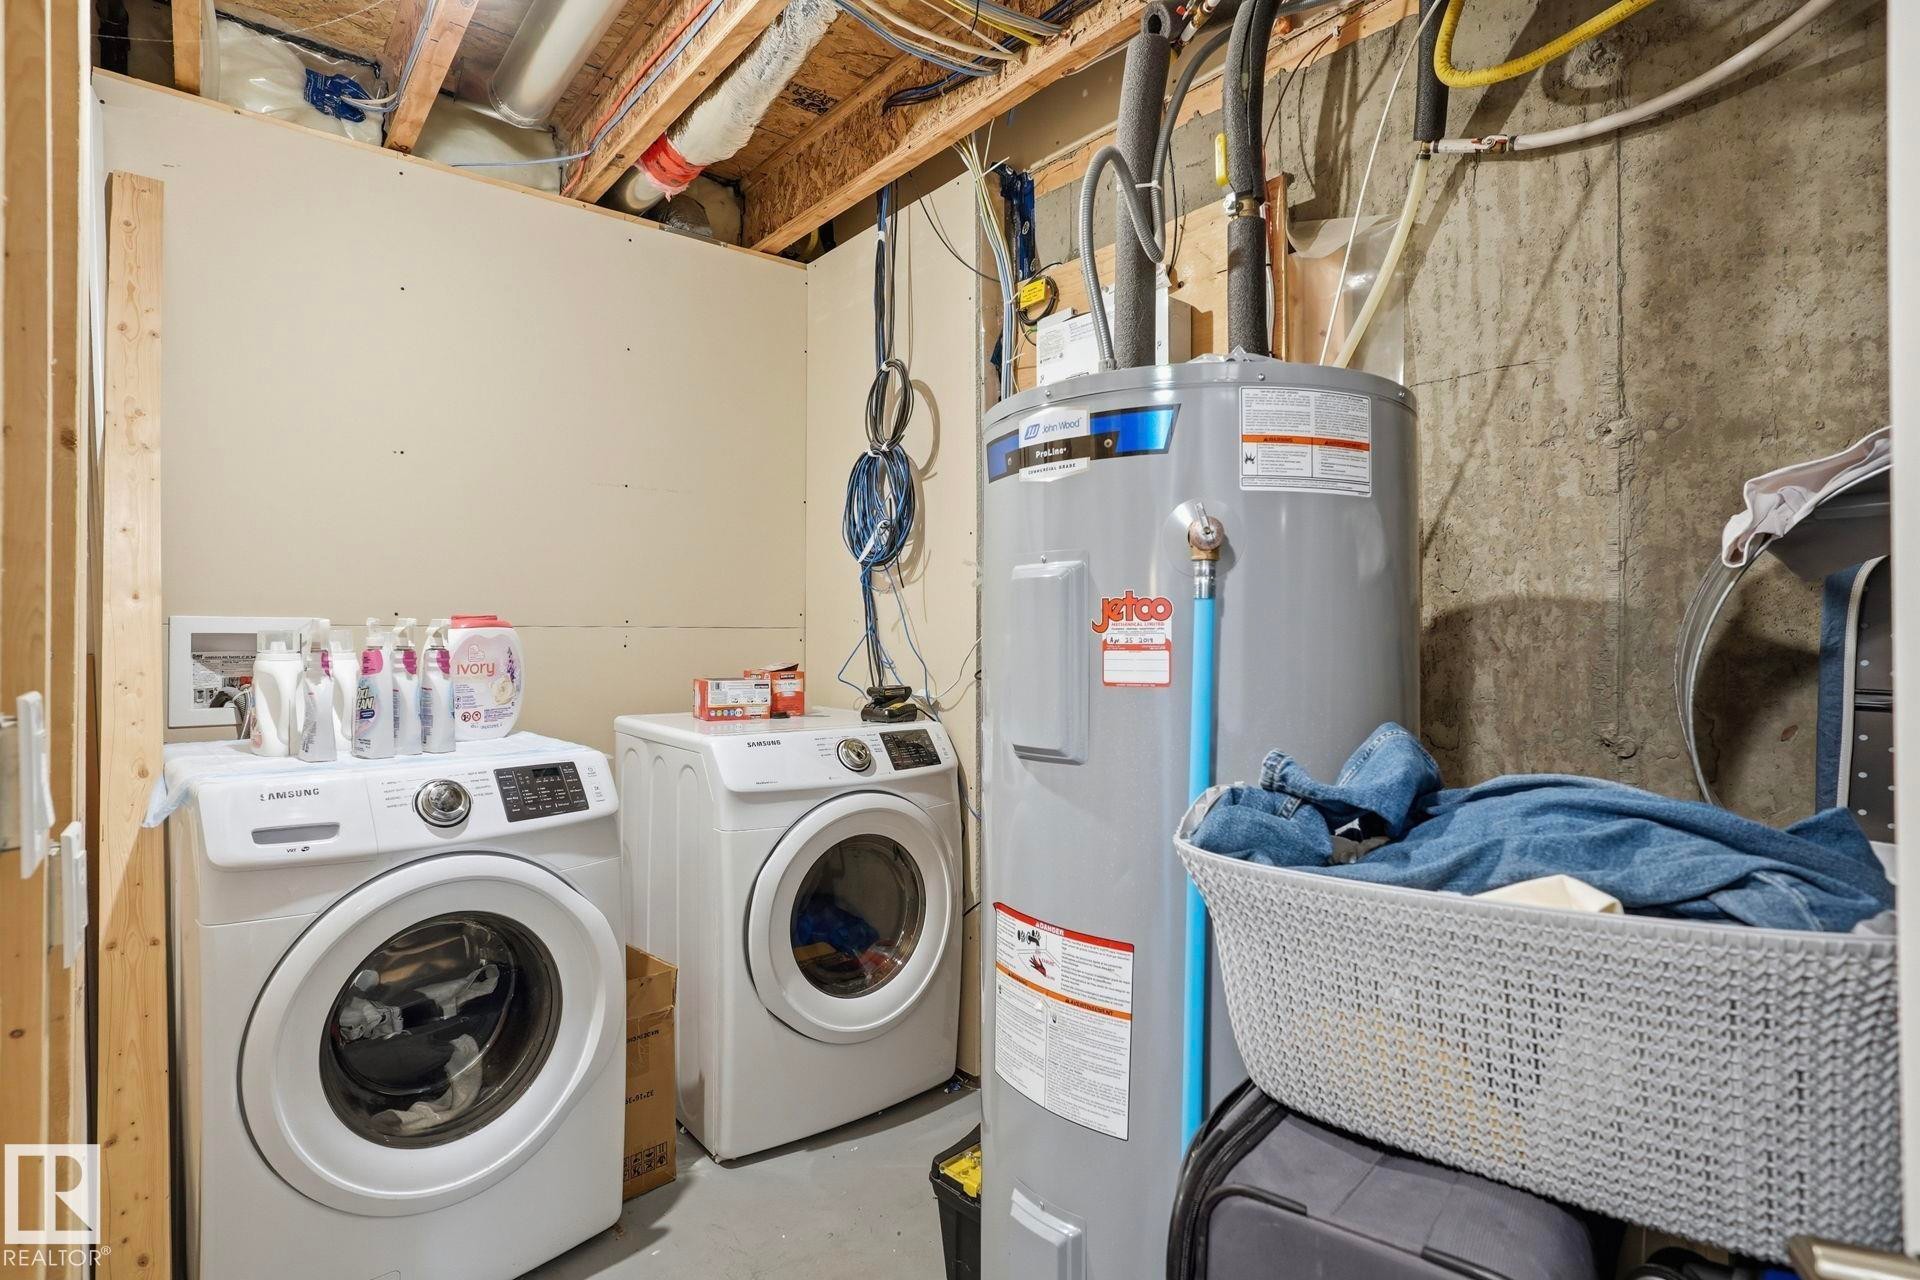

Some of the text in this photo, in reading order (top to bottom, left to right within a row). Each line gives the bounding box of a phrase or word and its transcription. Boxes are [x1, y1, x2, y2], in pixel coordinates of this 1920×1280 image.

[1042, 419, 1080, 434] John Wood
[747, 739, 781, 748] SAMSUNG
[260, 788, 320, 801] SAMSUNG
[1040, 923, 1064, 936] DANGER
